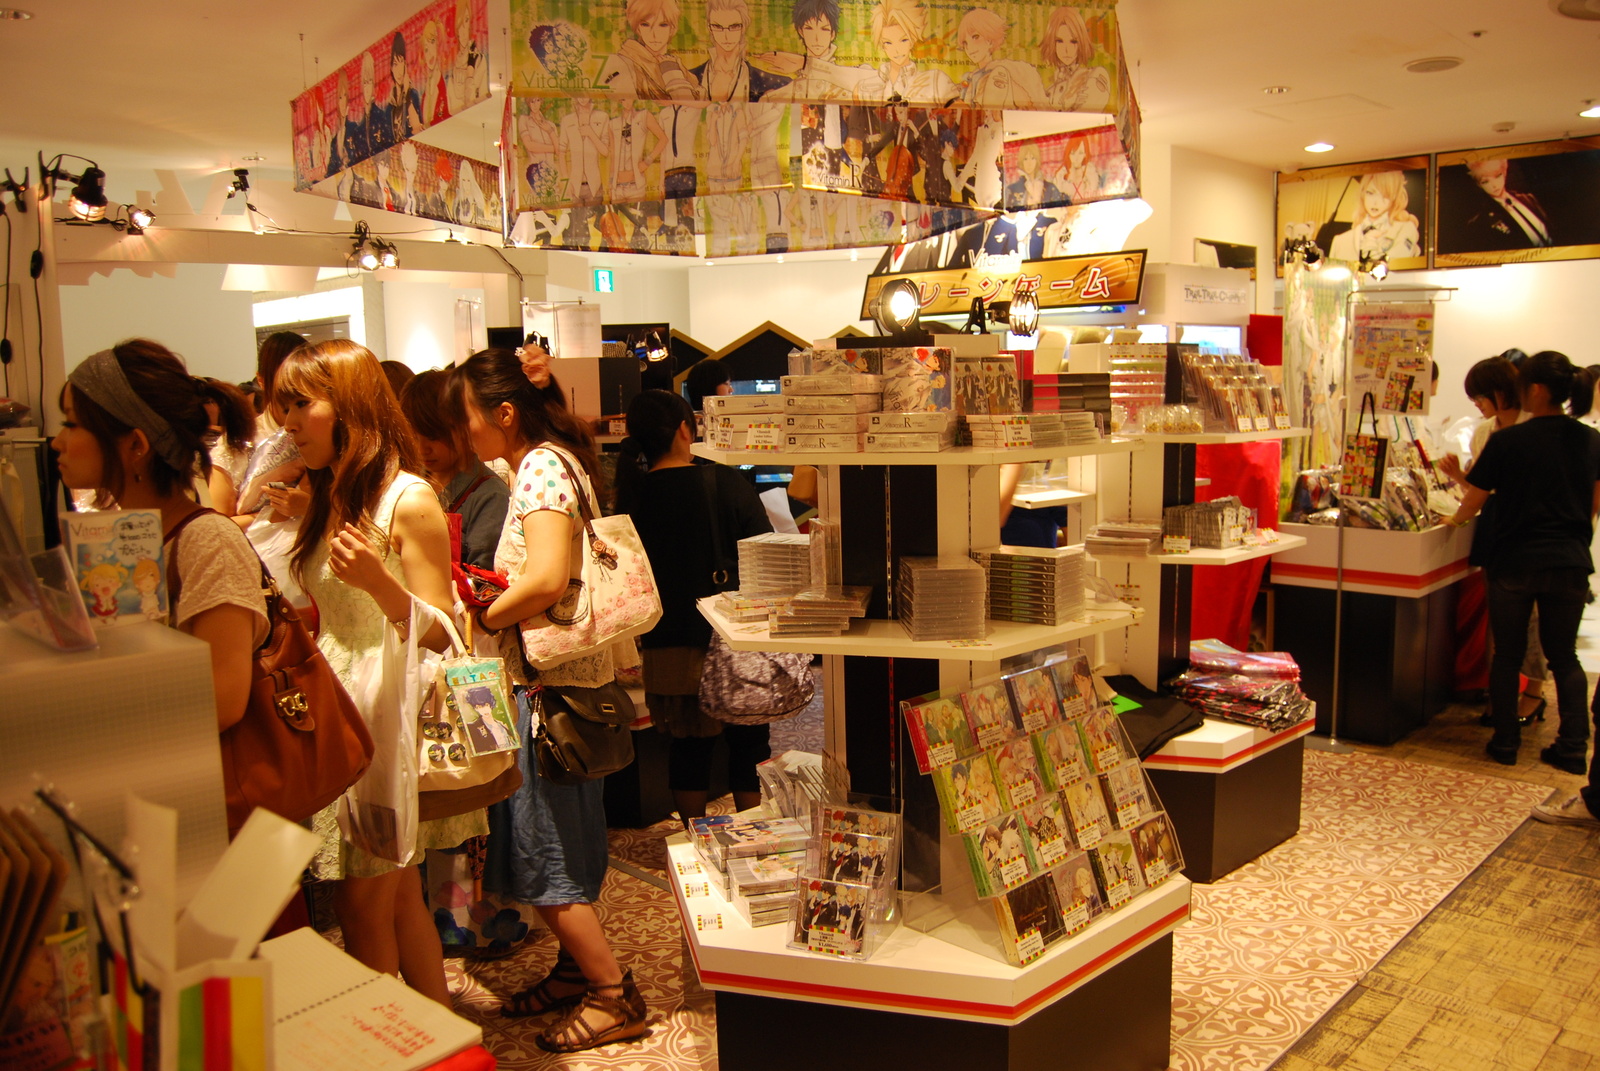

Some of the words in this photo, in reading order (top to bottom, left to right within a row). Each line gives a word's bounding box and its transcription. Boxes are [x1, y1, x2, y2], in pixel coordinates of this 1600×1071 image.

[521, 55, 611, 89] VitaminZ
[818, 163, 863, 189] VitaminR
[451, 673, 487, 686] EITA
